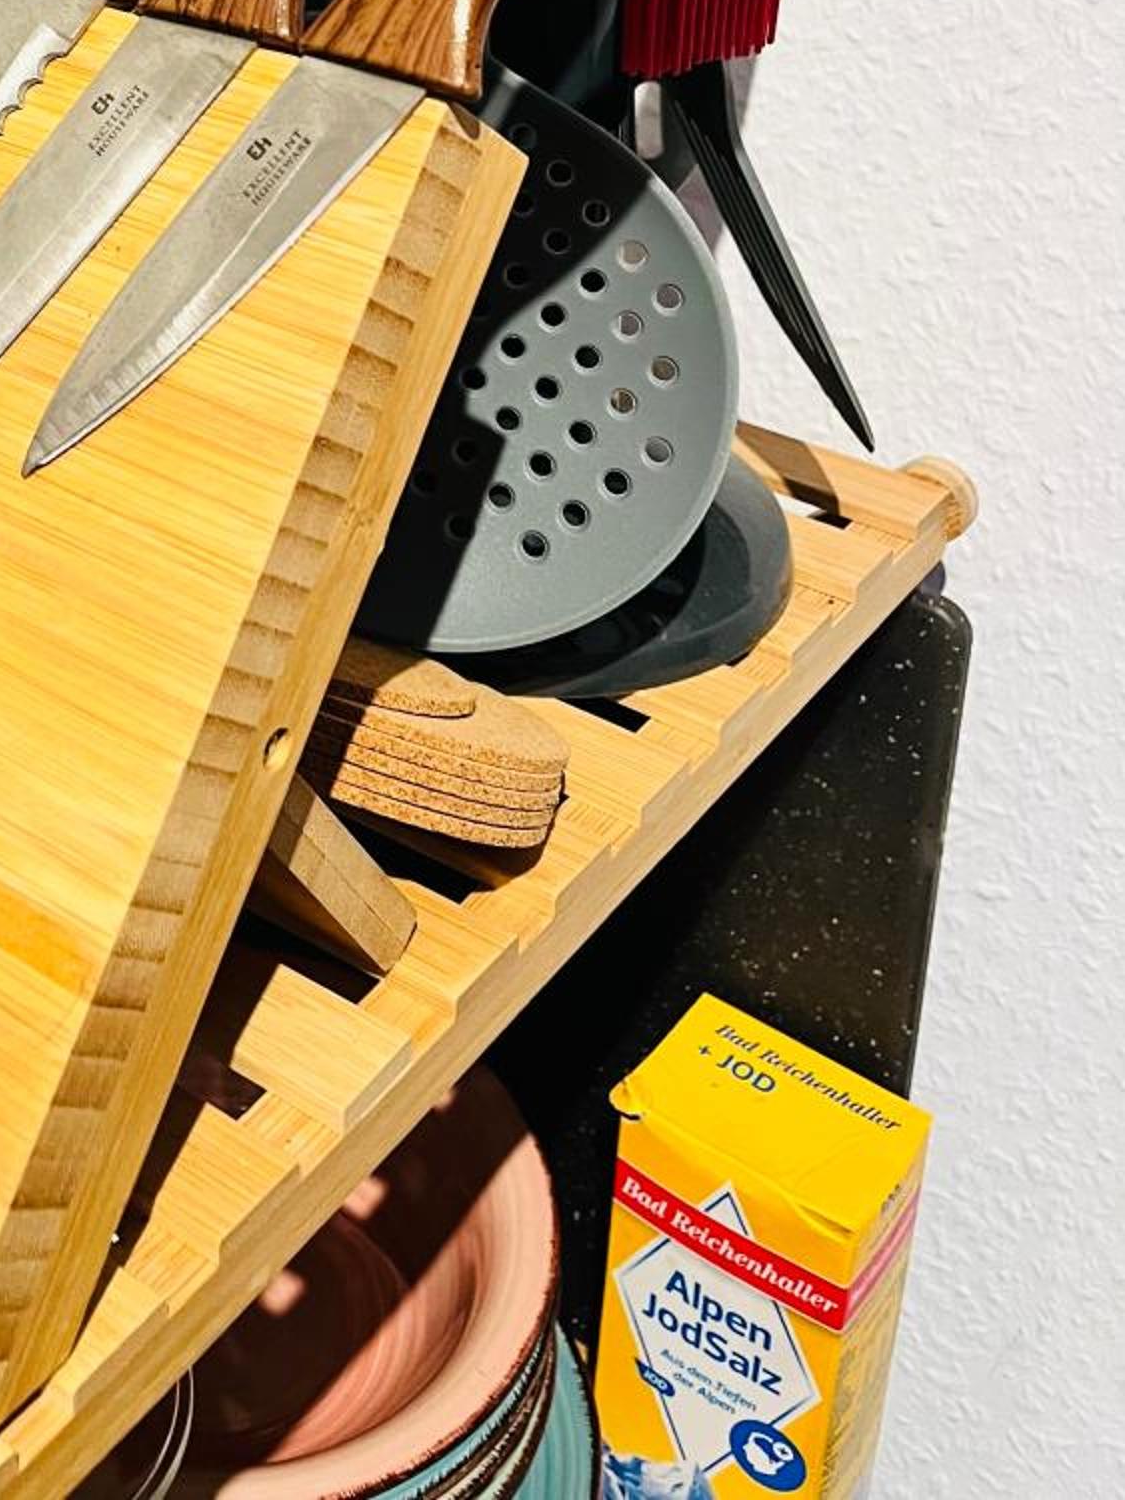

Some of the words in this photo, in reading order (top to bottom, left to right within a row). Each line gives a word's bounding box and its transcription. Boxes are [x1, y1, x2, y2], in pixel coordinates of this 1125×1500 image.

[87, 84, 141, 151] EXCELLENT
[242, 130, 302, 198] EXCELLENT
[715, 1024, 761, 1052] Bad
[759, 1049, 902, 1131] Reichenhaller
[716, 1054, 776, 1093] JOD
[621, 1176, 669, 1220] Bad
[670, 1209, 839, 1314] Reichenhaller
[642, 1293, 782, 1396] JodSalz
[665, 1270, 772, 1351] Alpen
